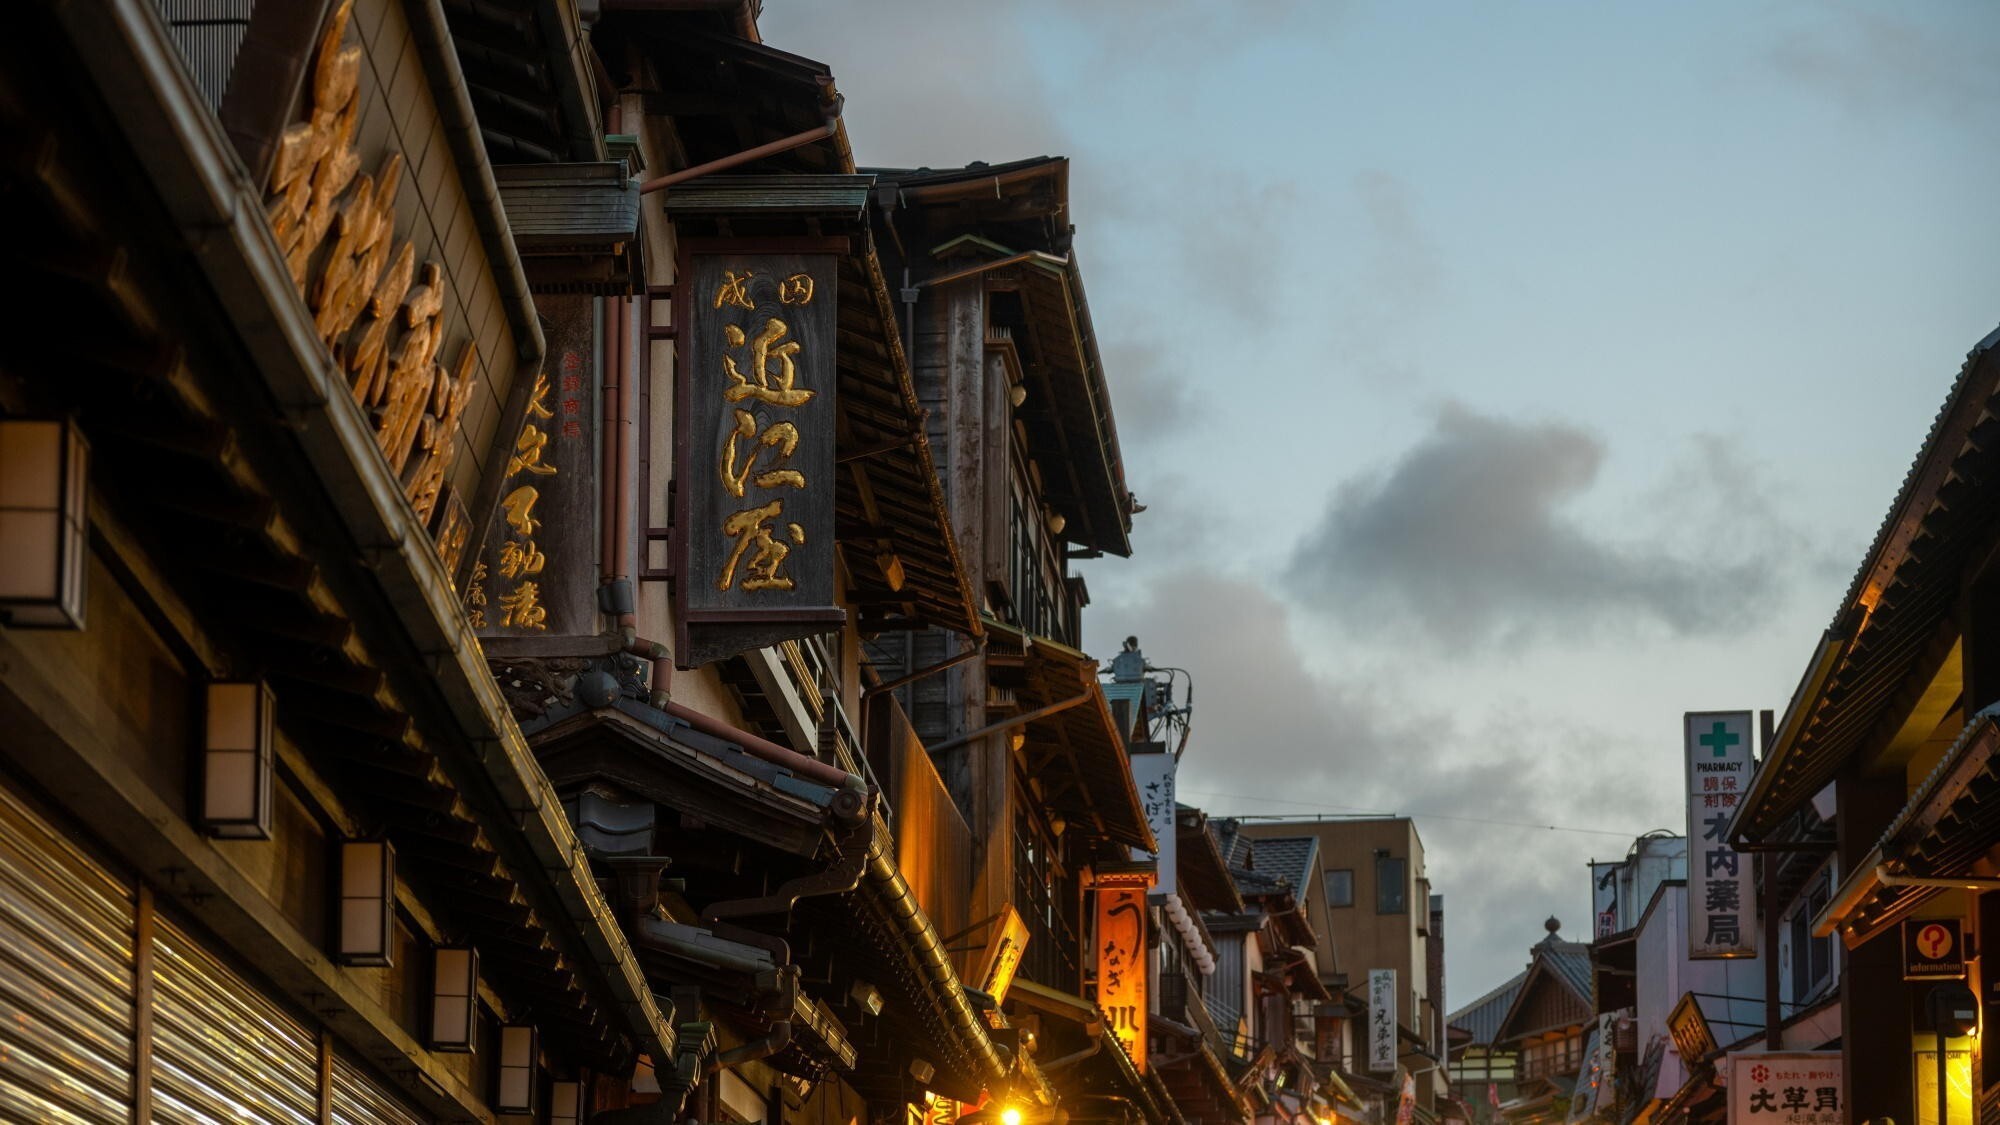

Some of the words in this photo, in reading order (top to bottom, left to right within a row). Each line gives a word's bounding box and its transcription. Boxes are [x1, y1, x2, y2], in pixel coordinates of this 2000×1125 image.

[713, 270, 815, 312] 成田
[718, 317, 817, 593] 近江屋
[1697, 762, 1743, 772] PHARMACY
[1703, 812, 1740, 946] 木内薬局
[1104, 892, 1142, 996] うなぎ
[1910, 962, 1961, 973] information
[1749, 1086, 1844, 1114] 大草胃
